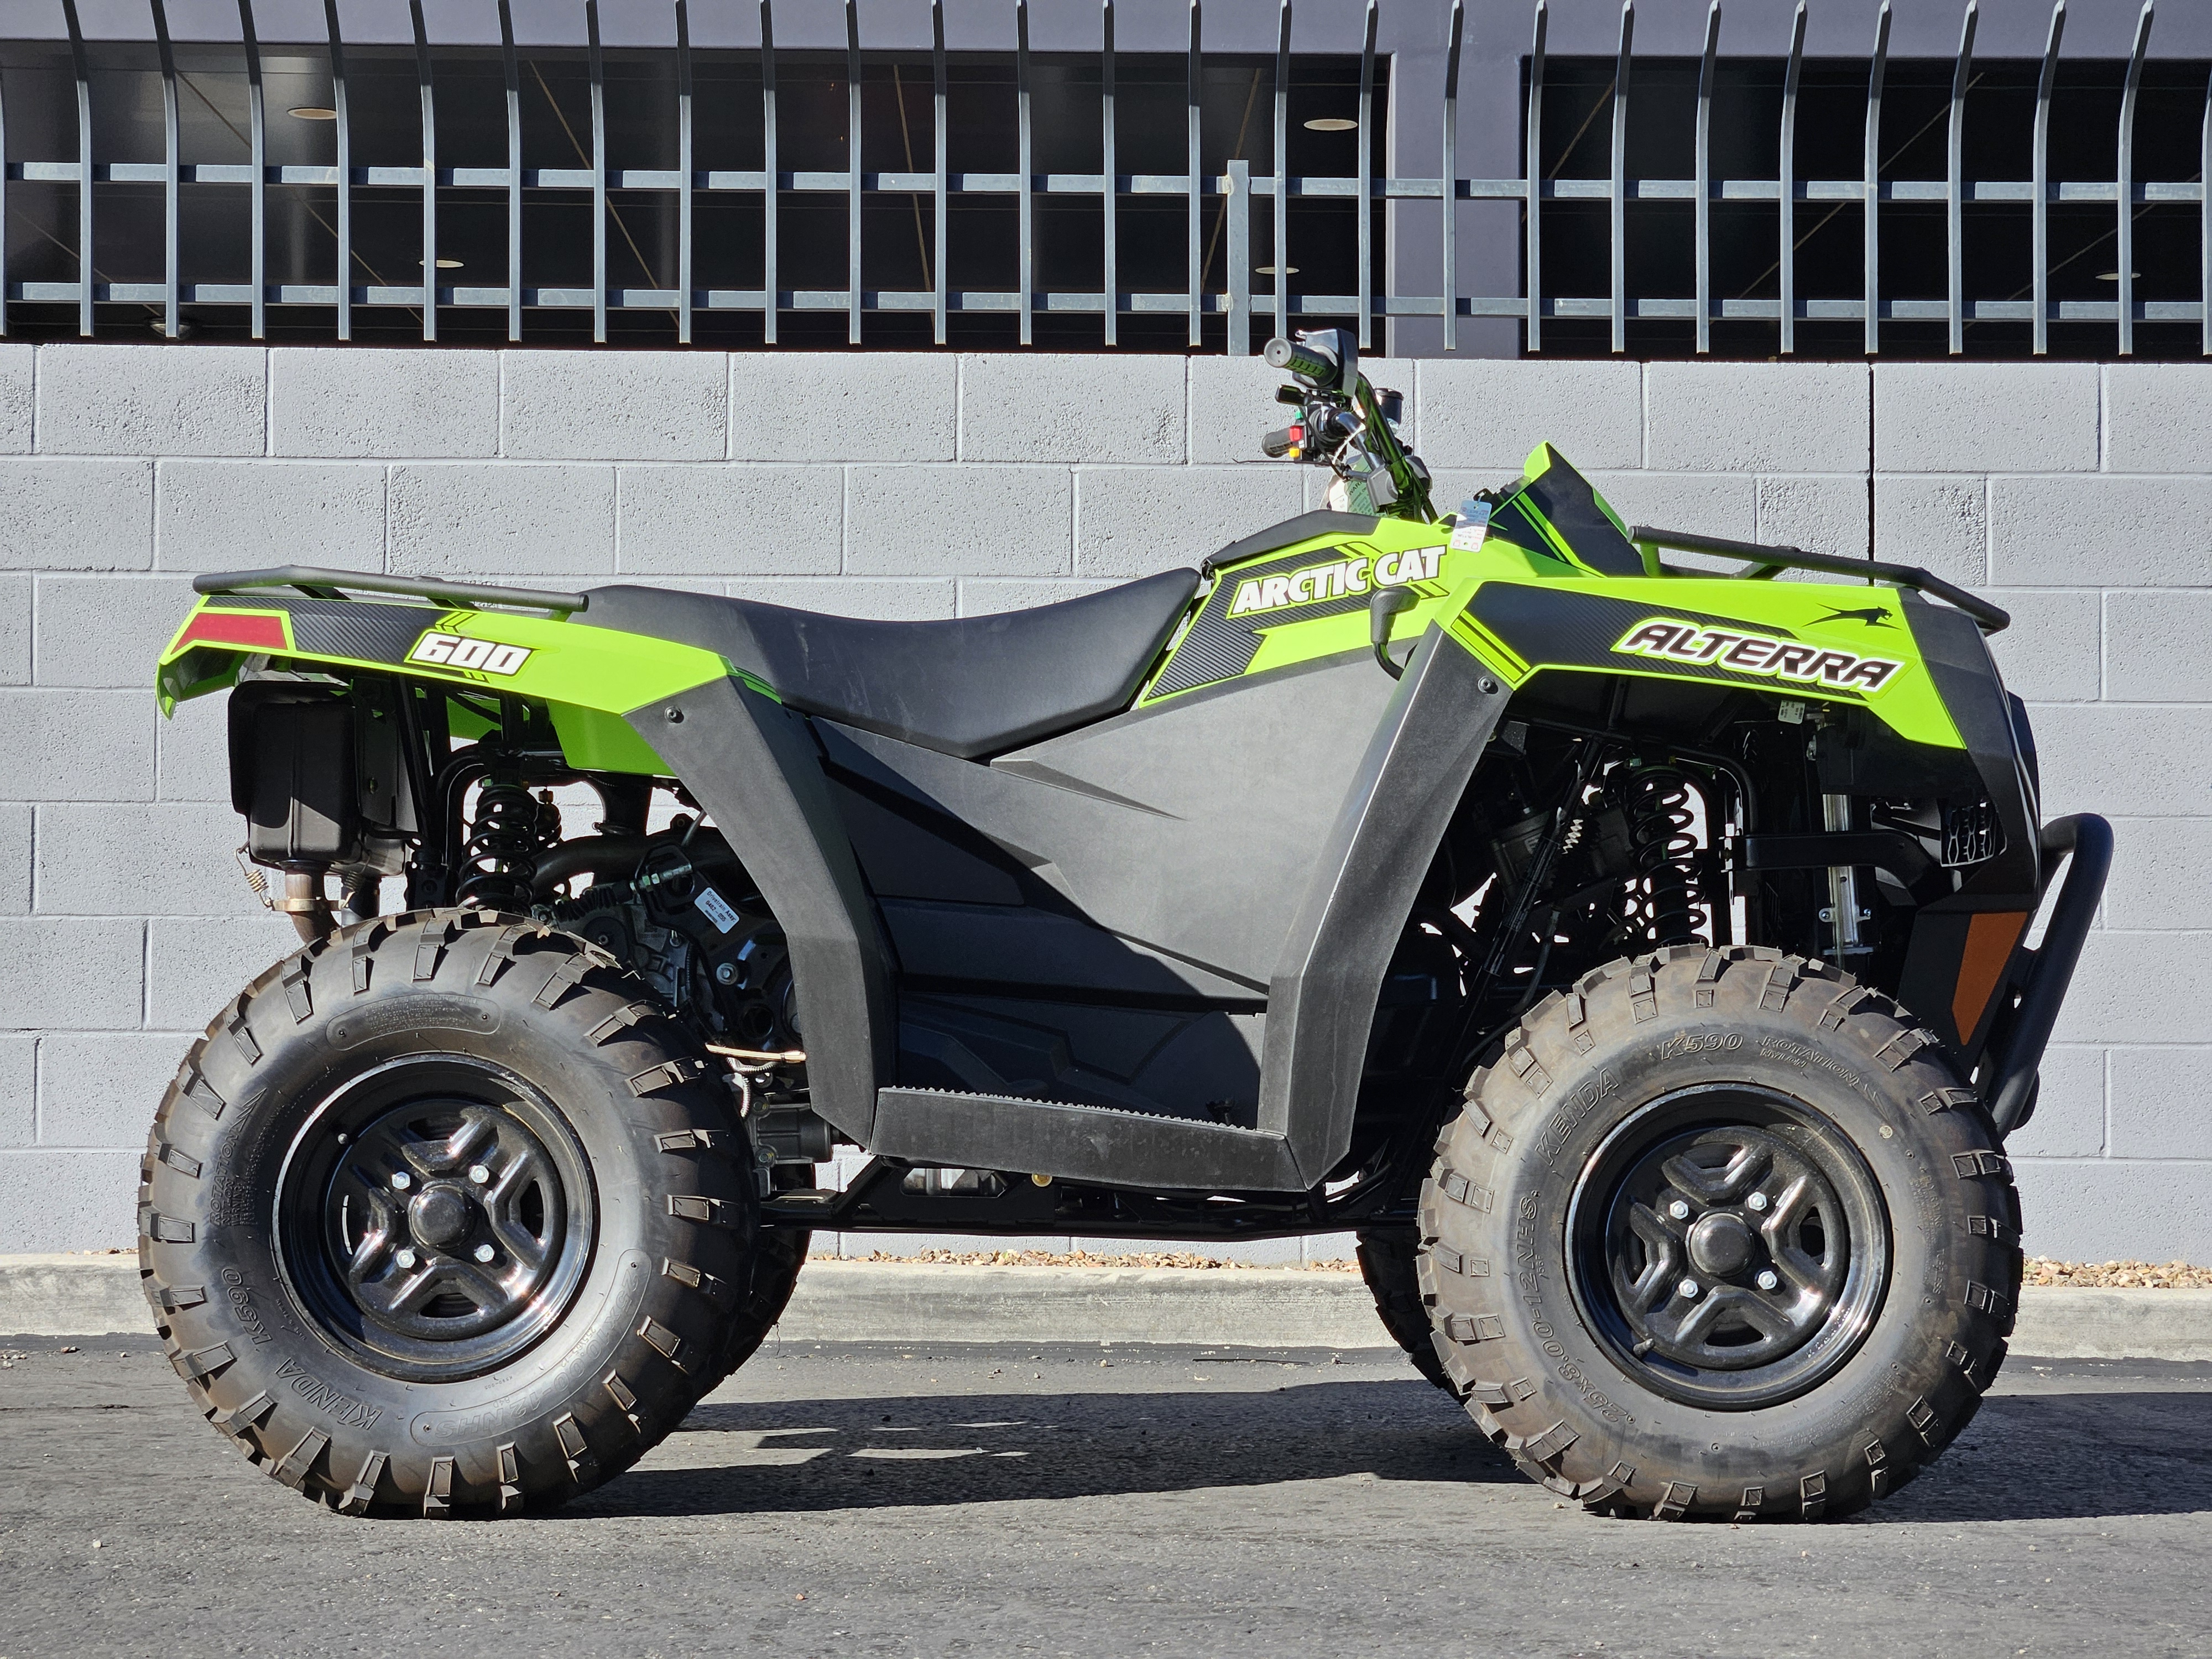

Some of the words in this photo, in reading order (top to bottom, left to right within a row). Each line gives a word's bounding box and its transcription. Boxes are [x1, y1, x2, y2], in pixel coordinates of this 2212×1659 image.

[1232, 557, 1369, 614] ARCTIC
[1374, 546, 1446, 586] CAT
[411, 633, 531, 675] 600
[1625, 623, 1900, 688] ALTERRA
[707, 891, 726, 911] Drivetrain
[1661, 1032, 1743, 1061] K590
[1760, 1048, 1808, 1068] NYLON
[1761, 1035, 1860, 1086] ROTATION
[1535, 1067, 1620, 1166] KENDA
[209, 1133, 238, 1226] ROTATION
[222, 1267, 273, 1345] K590
[275, 1357, 383, 1430] KENDA
